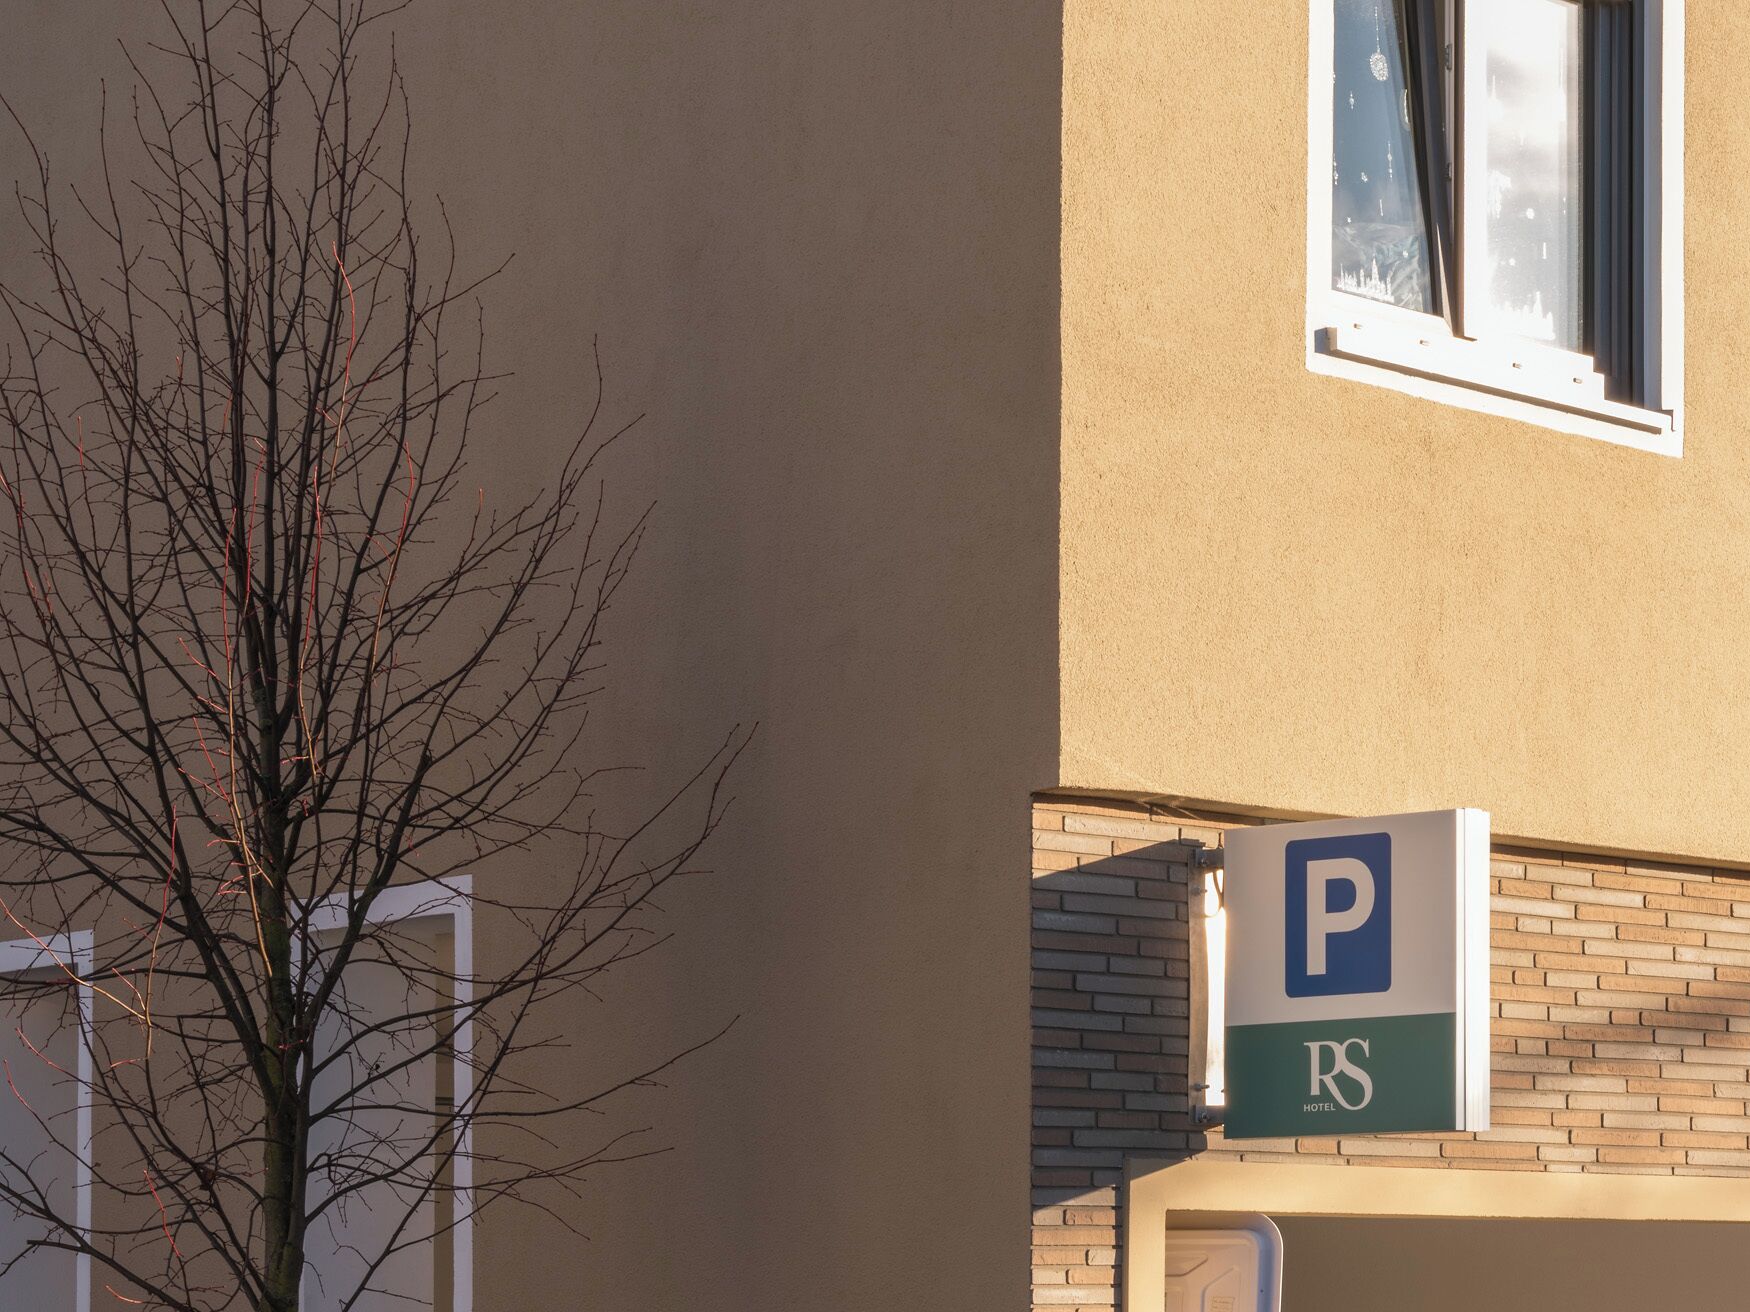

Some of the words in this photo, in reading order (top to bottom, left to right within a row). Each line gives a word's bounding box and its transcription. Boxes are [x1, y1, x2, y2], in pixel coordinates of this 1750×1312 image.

[1306, 857, 1375, 976] P
[1303, 1037, 1374, 1111] RS
[1303, 1102, 1336, 1112] HOTEL
